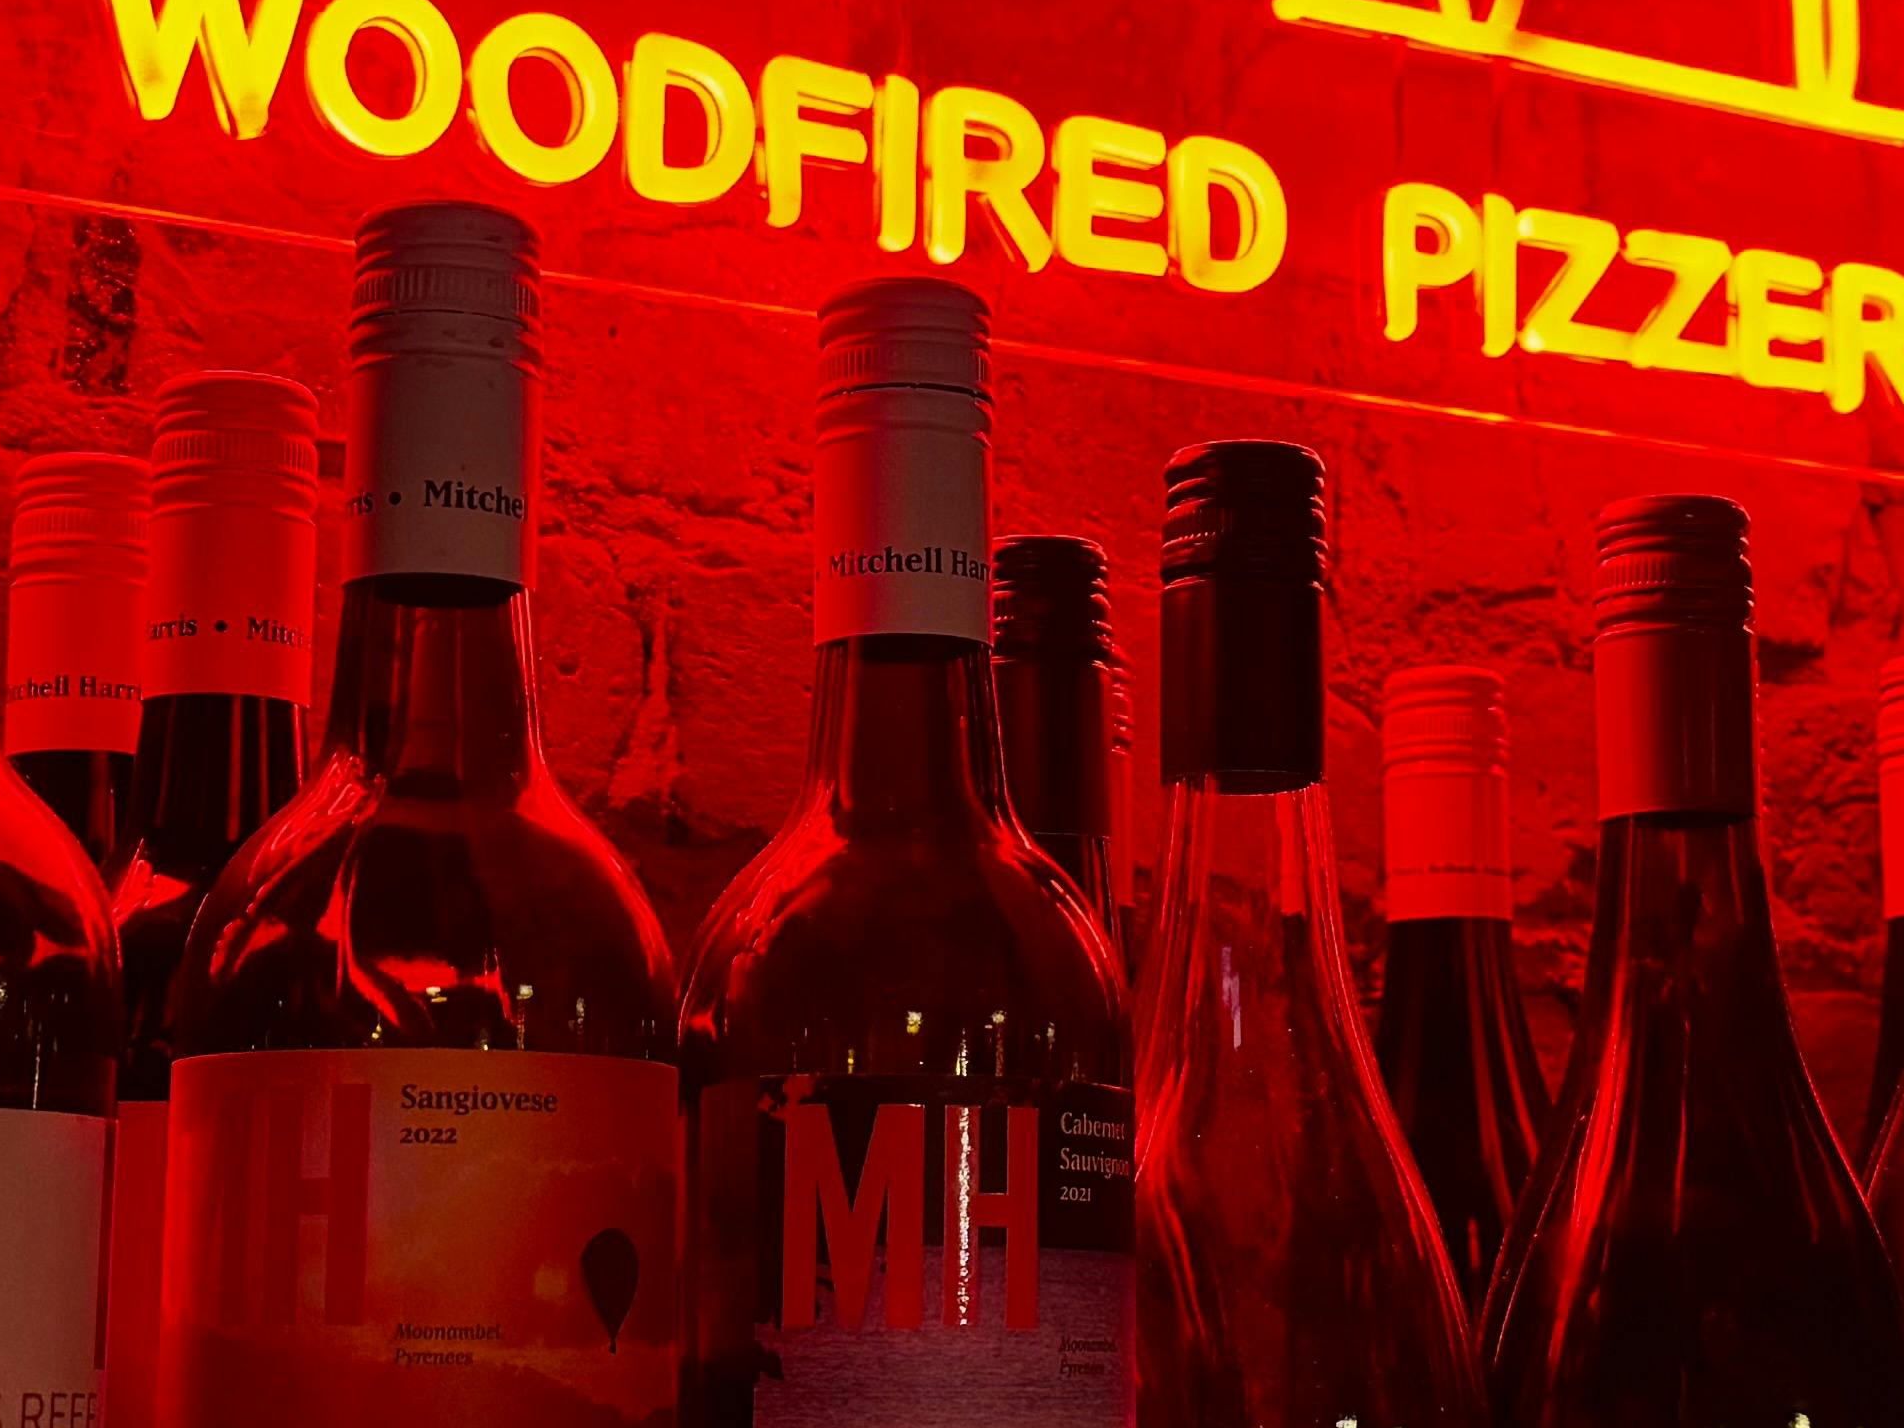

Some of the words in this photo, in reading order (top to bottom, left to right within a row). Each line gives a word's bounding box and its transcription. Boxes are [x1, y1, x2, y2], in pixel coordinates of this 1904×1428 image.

[830, 545, 943, 578] Mitchell
[400, 1083, 559, 1116] Sangiovese
[399, 1127, 457, 1145] 2022
[1059, 1185, 1092, 1203] 2021
[782, 1102, 1041, 1330] MH
